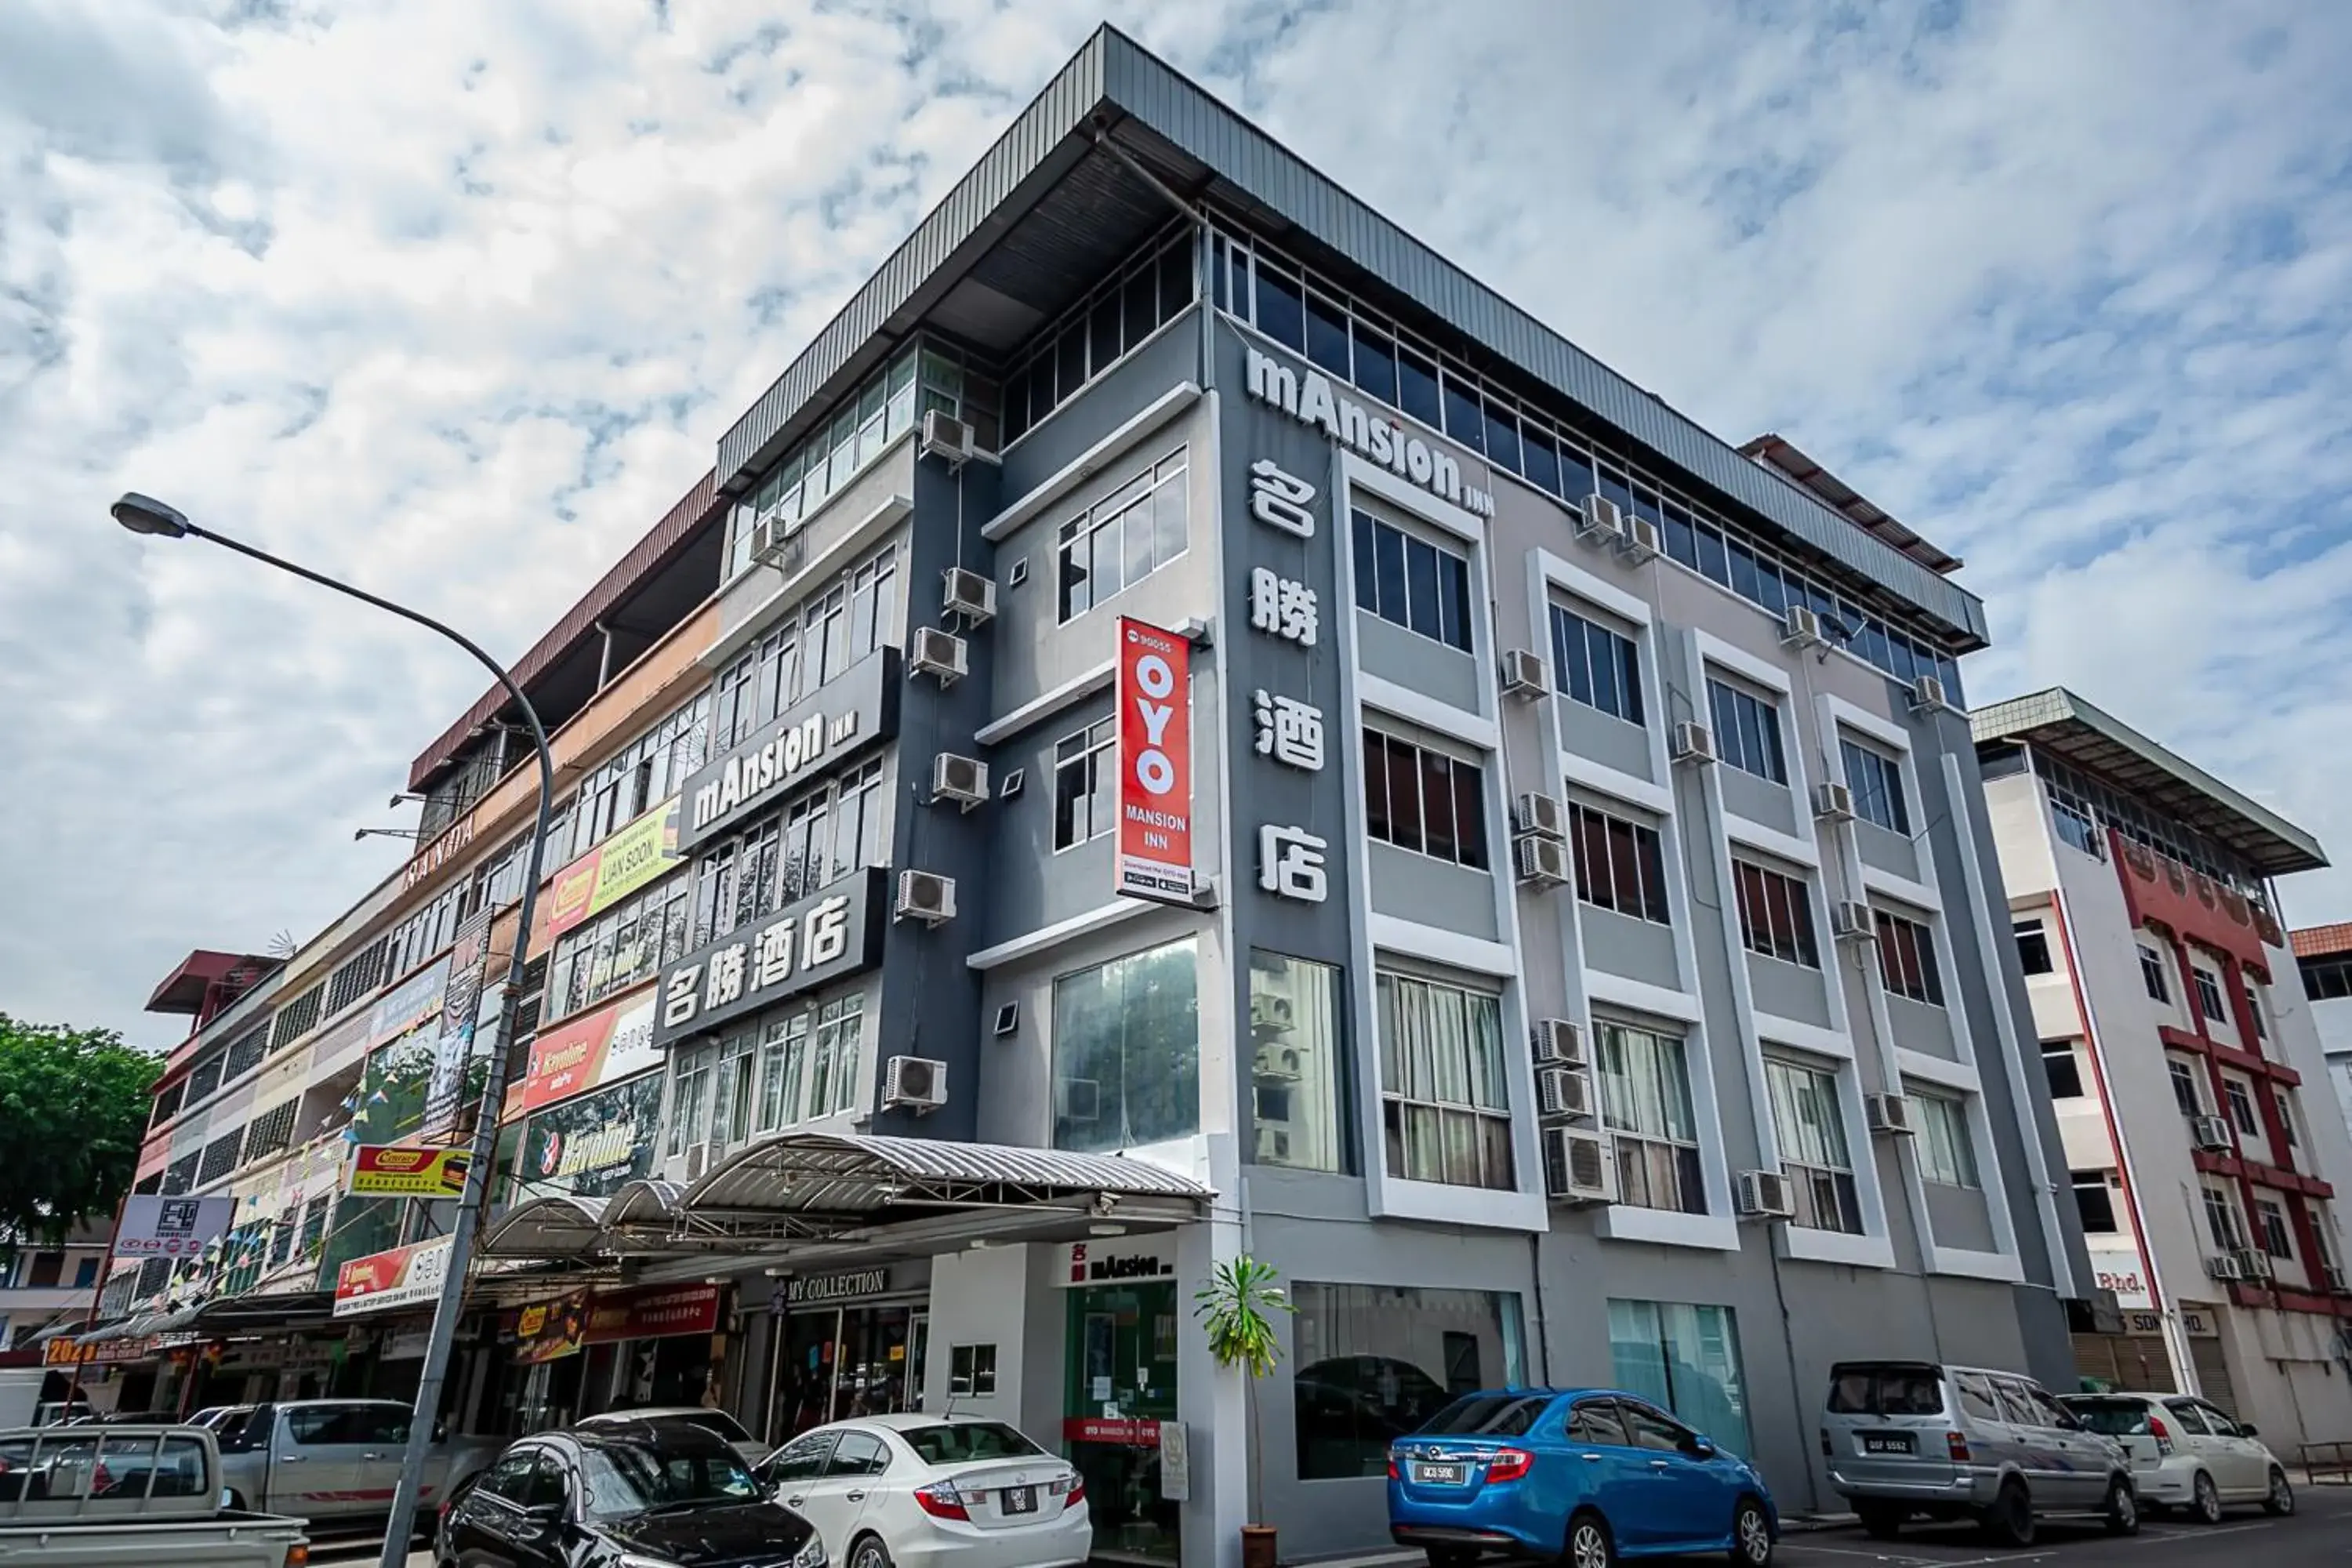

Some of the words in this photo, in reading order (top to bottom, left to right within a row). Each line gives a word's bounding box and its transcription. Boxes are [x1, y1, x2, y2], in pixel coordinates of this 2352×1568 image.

[1249, 458, 1329, 905] 名勝酒店
[829, 709, 858, 746] INN
[1136, 654, 1174, 795] OYO
[1126, 804, 1186, 832] MANSION
[1144, 830, 1168, 850] INN
[664, 895, 850, 1029] 名勝酒店
[808, 1270, 885, 1300] COLLECTION
